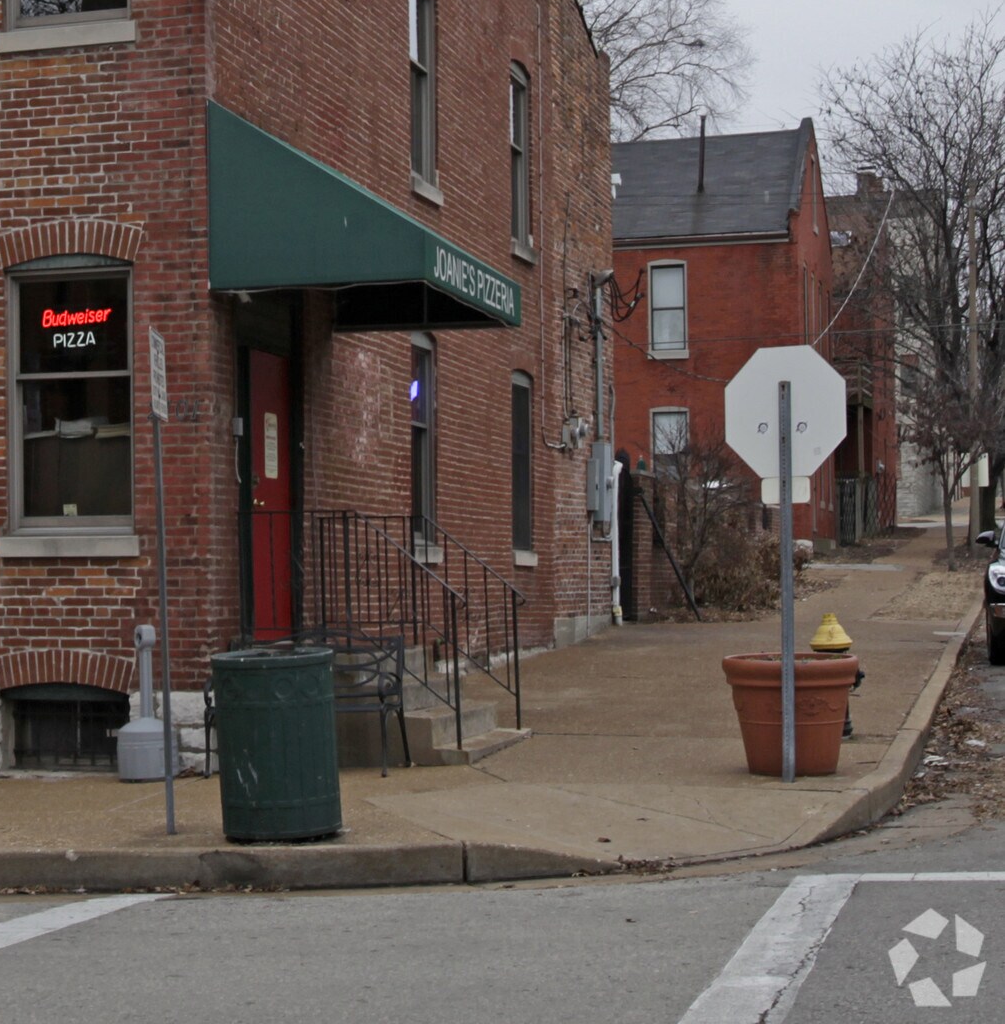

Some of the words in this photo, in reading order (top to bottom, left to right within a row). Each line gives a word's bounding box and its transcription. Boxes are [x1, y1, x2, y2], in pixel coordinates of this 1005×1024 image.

[434, 246, 475, 297] JOANIE'S
[477, 269, 515, 316] PIZZERIA
[42, 308, 112, 328] Budweiser
[53, 331, 96, 348] PIZZA
